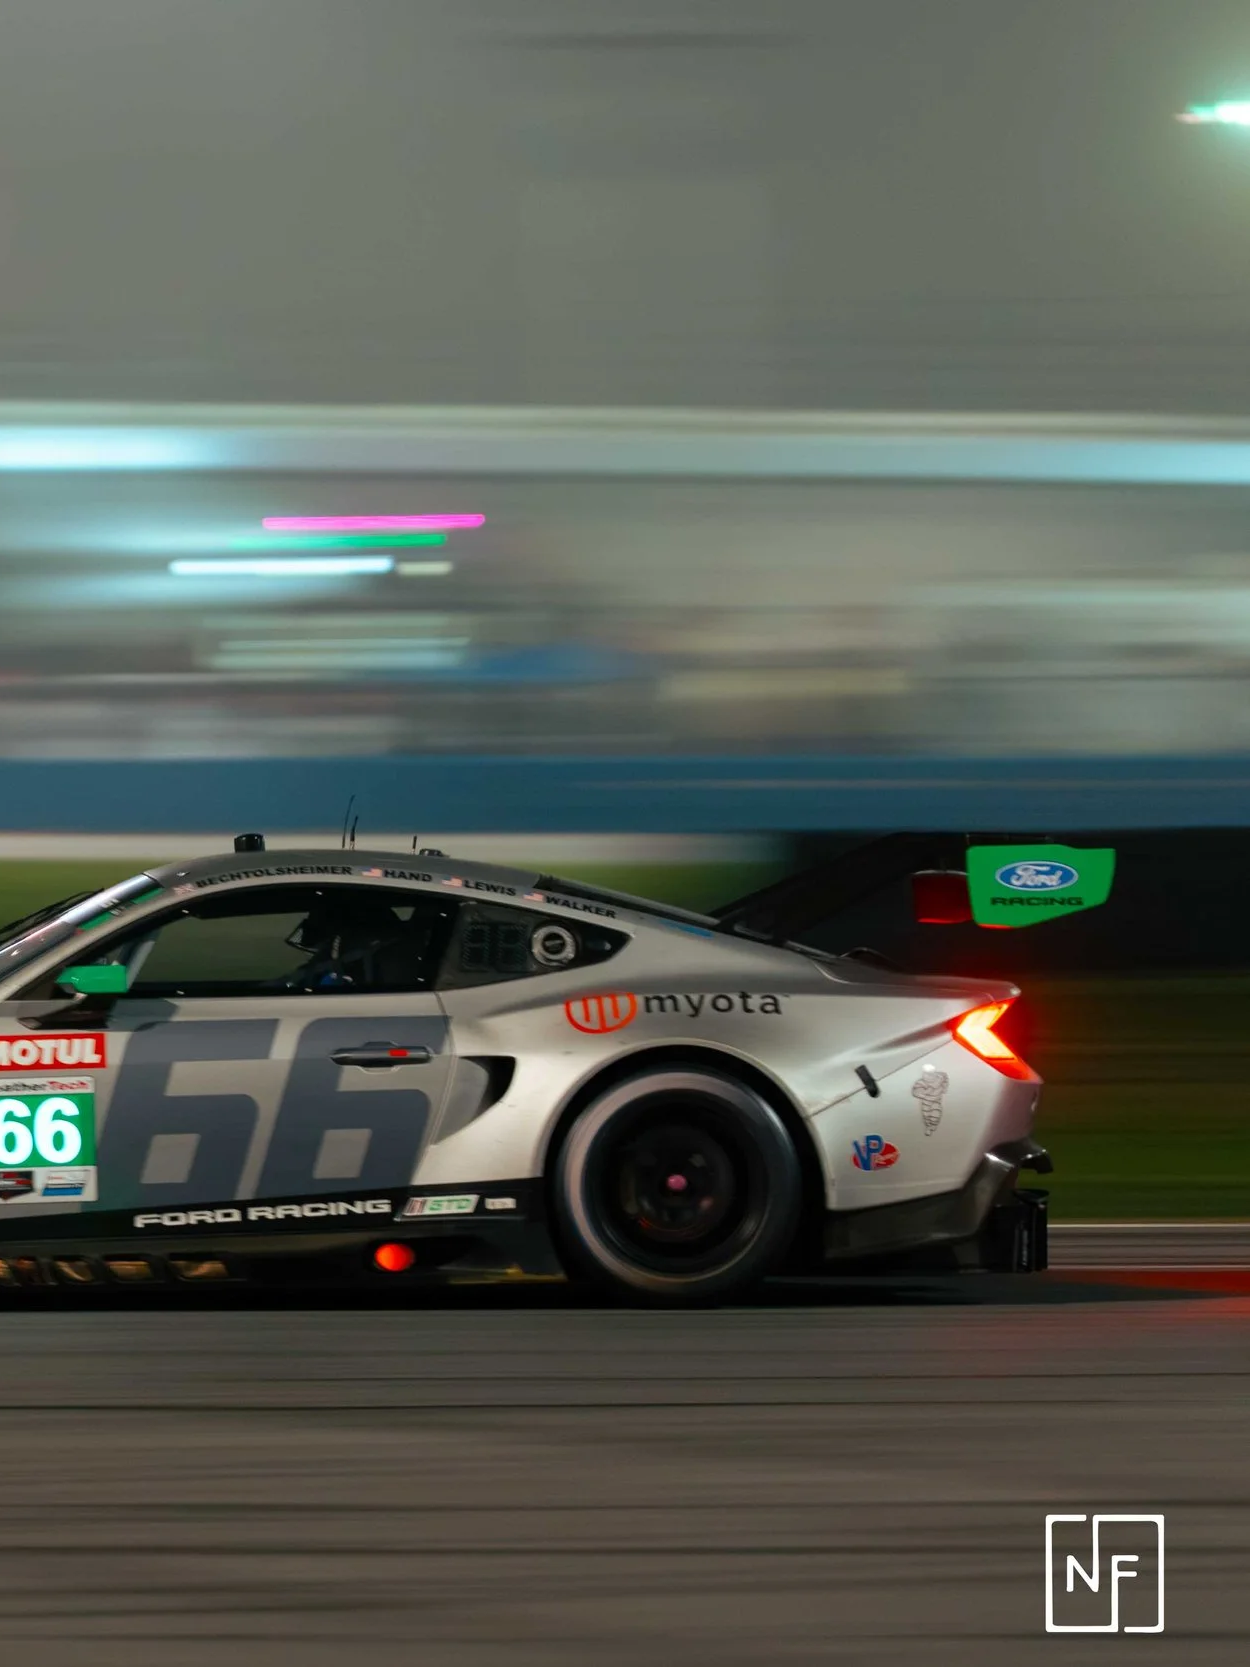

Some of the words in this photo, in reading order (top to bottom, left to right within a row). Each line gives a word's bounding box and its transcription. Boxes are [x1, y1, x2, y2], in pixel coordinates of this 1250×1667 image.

[1011, 865, 1062, 886] Ford
[195, 866, 352, 888] BECHTOLSHEIMER
[384, 870, 432, 882] HAND
[464, 880, 516, 896] LEWIS
[546, 896, 617, 919] WALKER
[990, 897, 1083, 906] RACING
[644, 991, 782, 1017] myota
[80, 1015, 453, 1212] 66
[852, 1135, 884, 1171] VP
[134, 1208, 242, 1228] FORD
[248, 1199, 391, 1219] RACING
